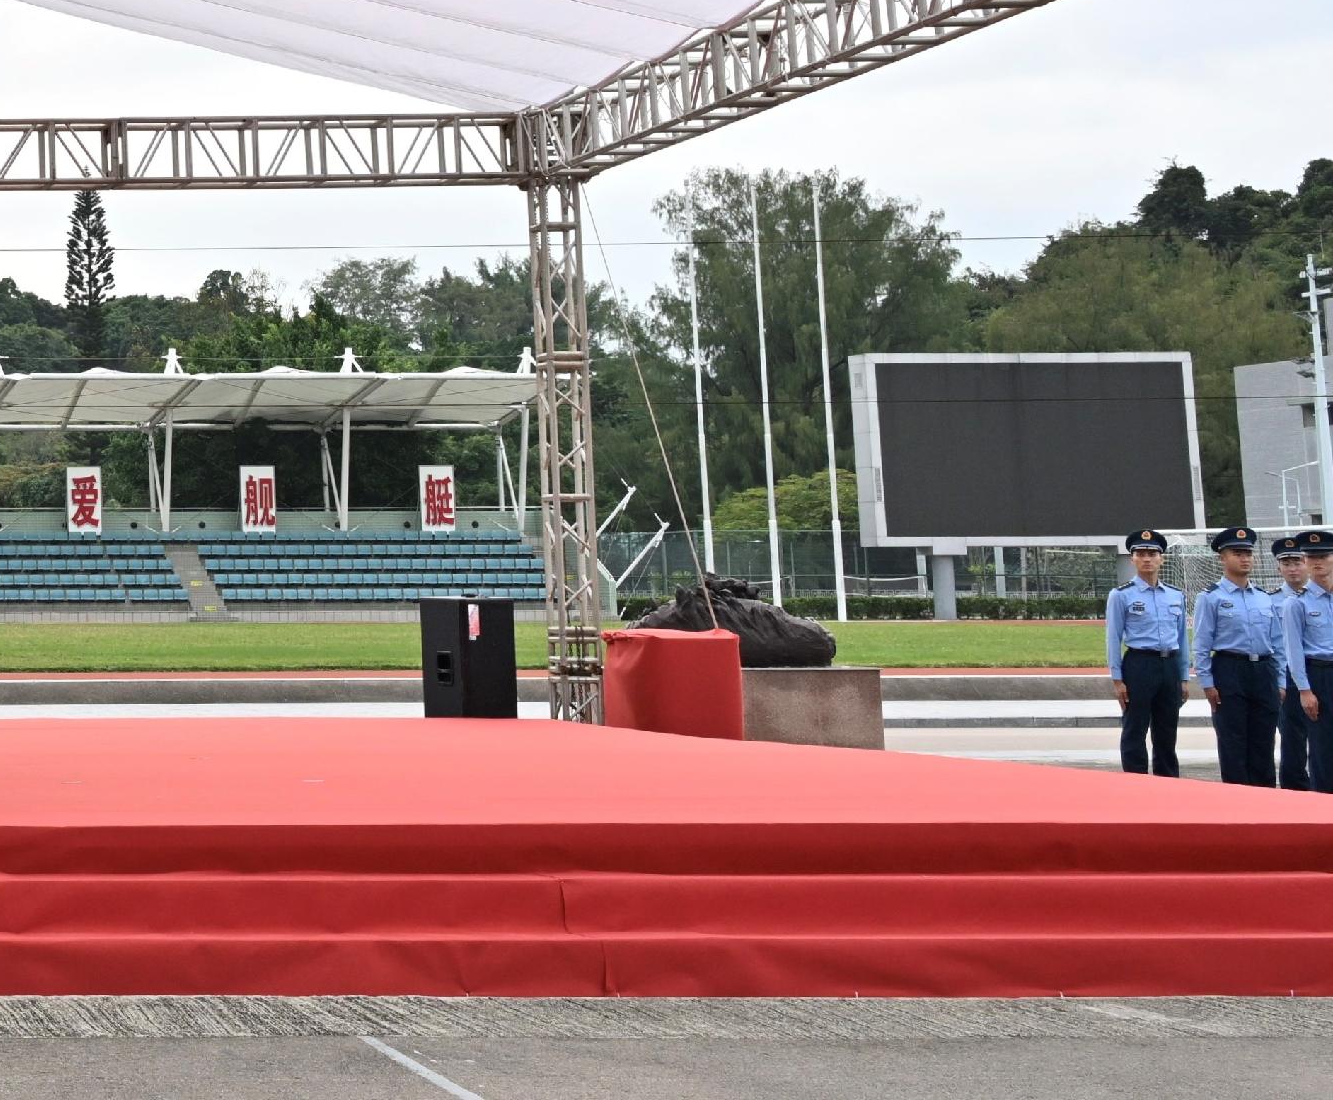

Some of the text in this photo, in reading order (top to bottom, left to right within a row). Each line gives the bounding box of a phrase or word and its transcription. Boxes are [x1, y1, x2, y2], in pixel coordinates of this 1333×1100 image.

[71, 475, 455, 527] 爱 舰 艇
